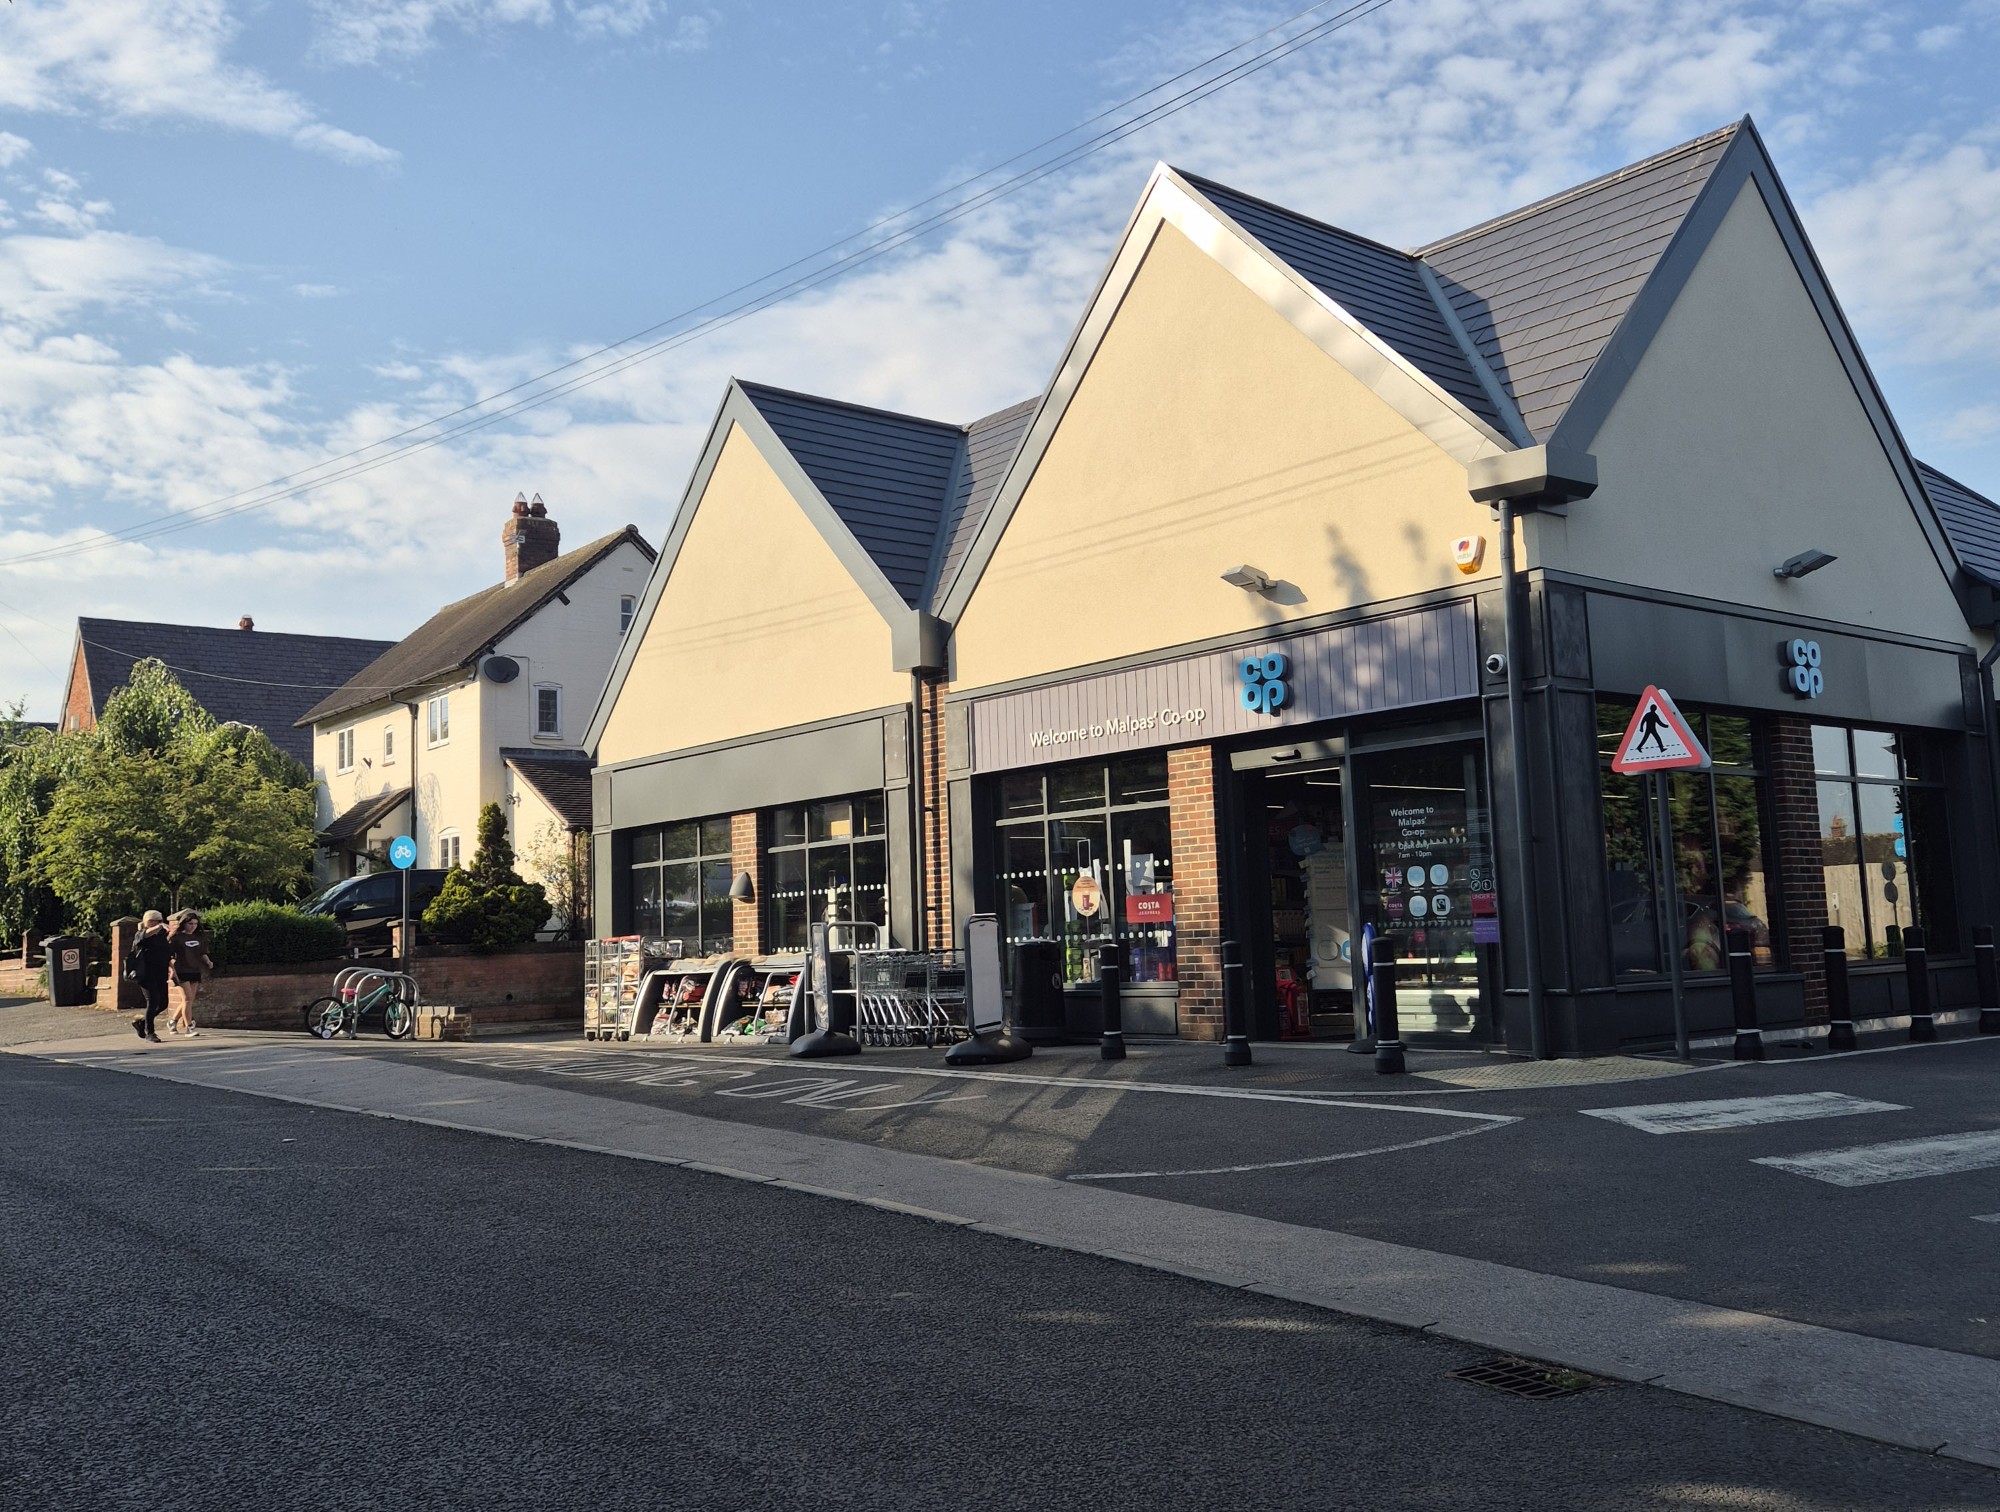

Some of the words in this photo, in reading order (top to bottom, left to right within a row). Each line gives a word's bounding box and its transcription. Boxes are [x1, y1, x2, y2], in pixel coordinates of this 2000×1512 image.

[1029, 726, 1088, 748] Welcome
[1089, 724, 1105, 738] to
[1106, 714, 1160, 737] Malpas'
[1160, 706, 1206, 726] Co-op
[1390, 807, 1425, 817] Welcome
[1426, 806, 1434, 814] to
[1401, 828, 1425, 837] Co-op
[1415, 850, 1432, 859] 10pm
[1137, 901, 1161, 910] COSTA
[714, 1077, 989, 1111] ONLY
